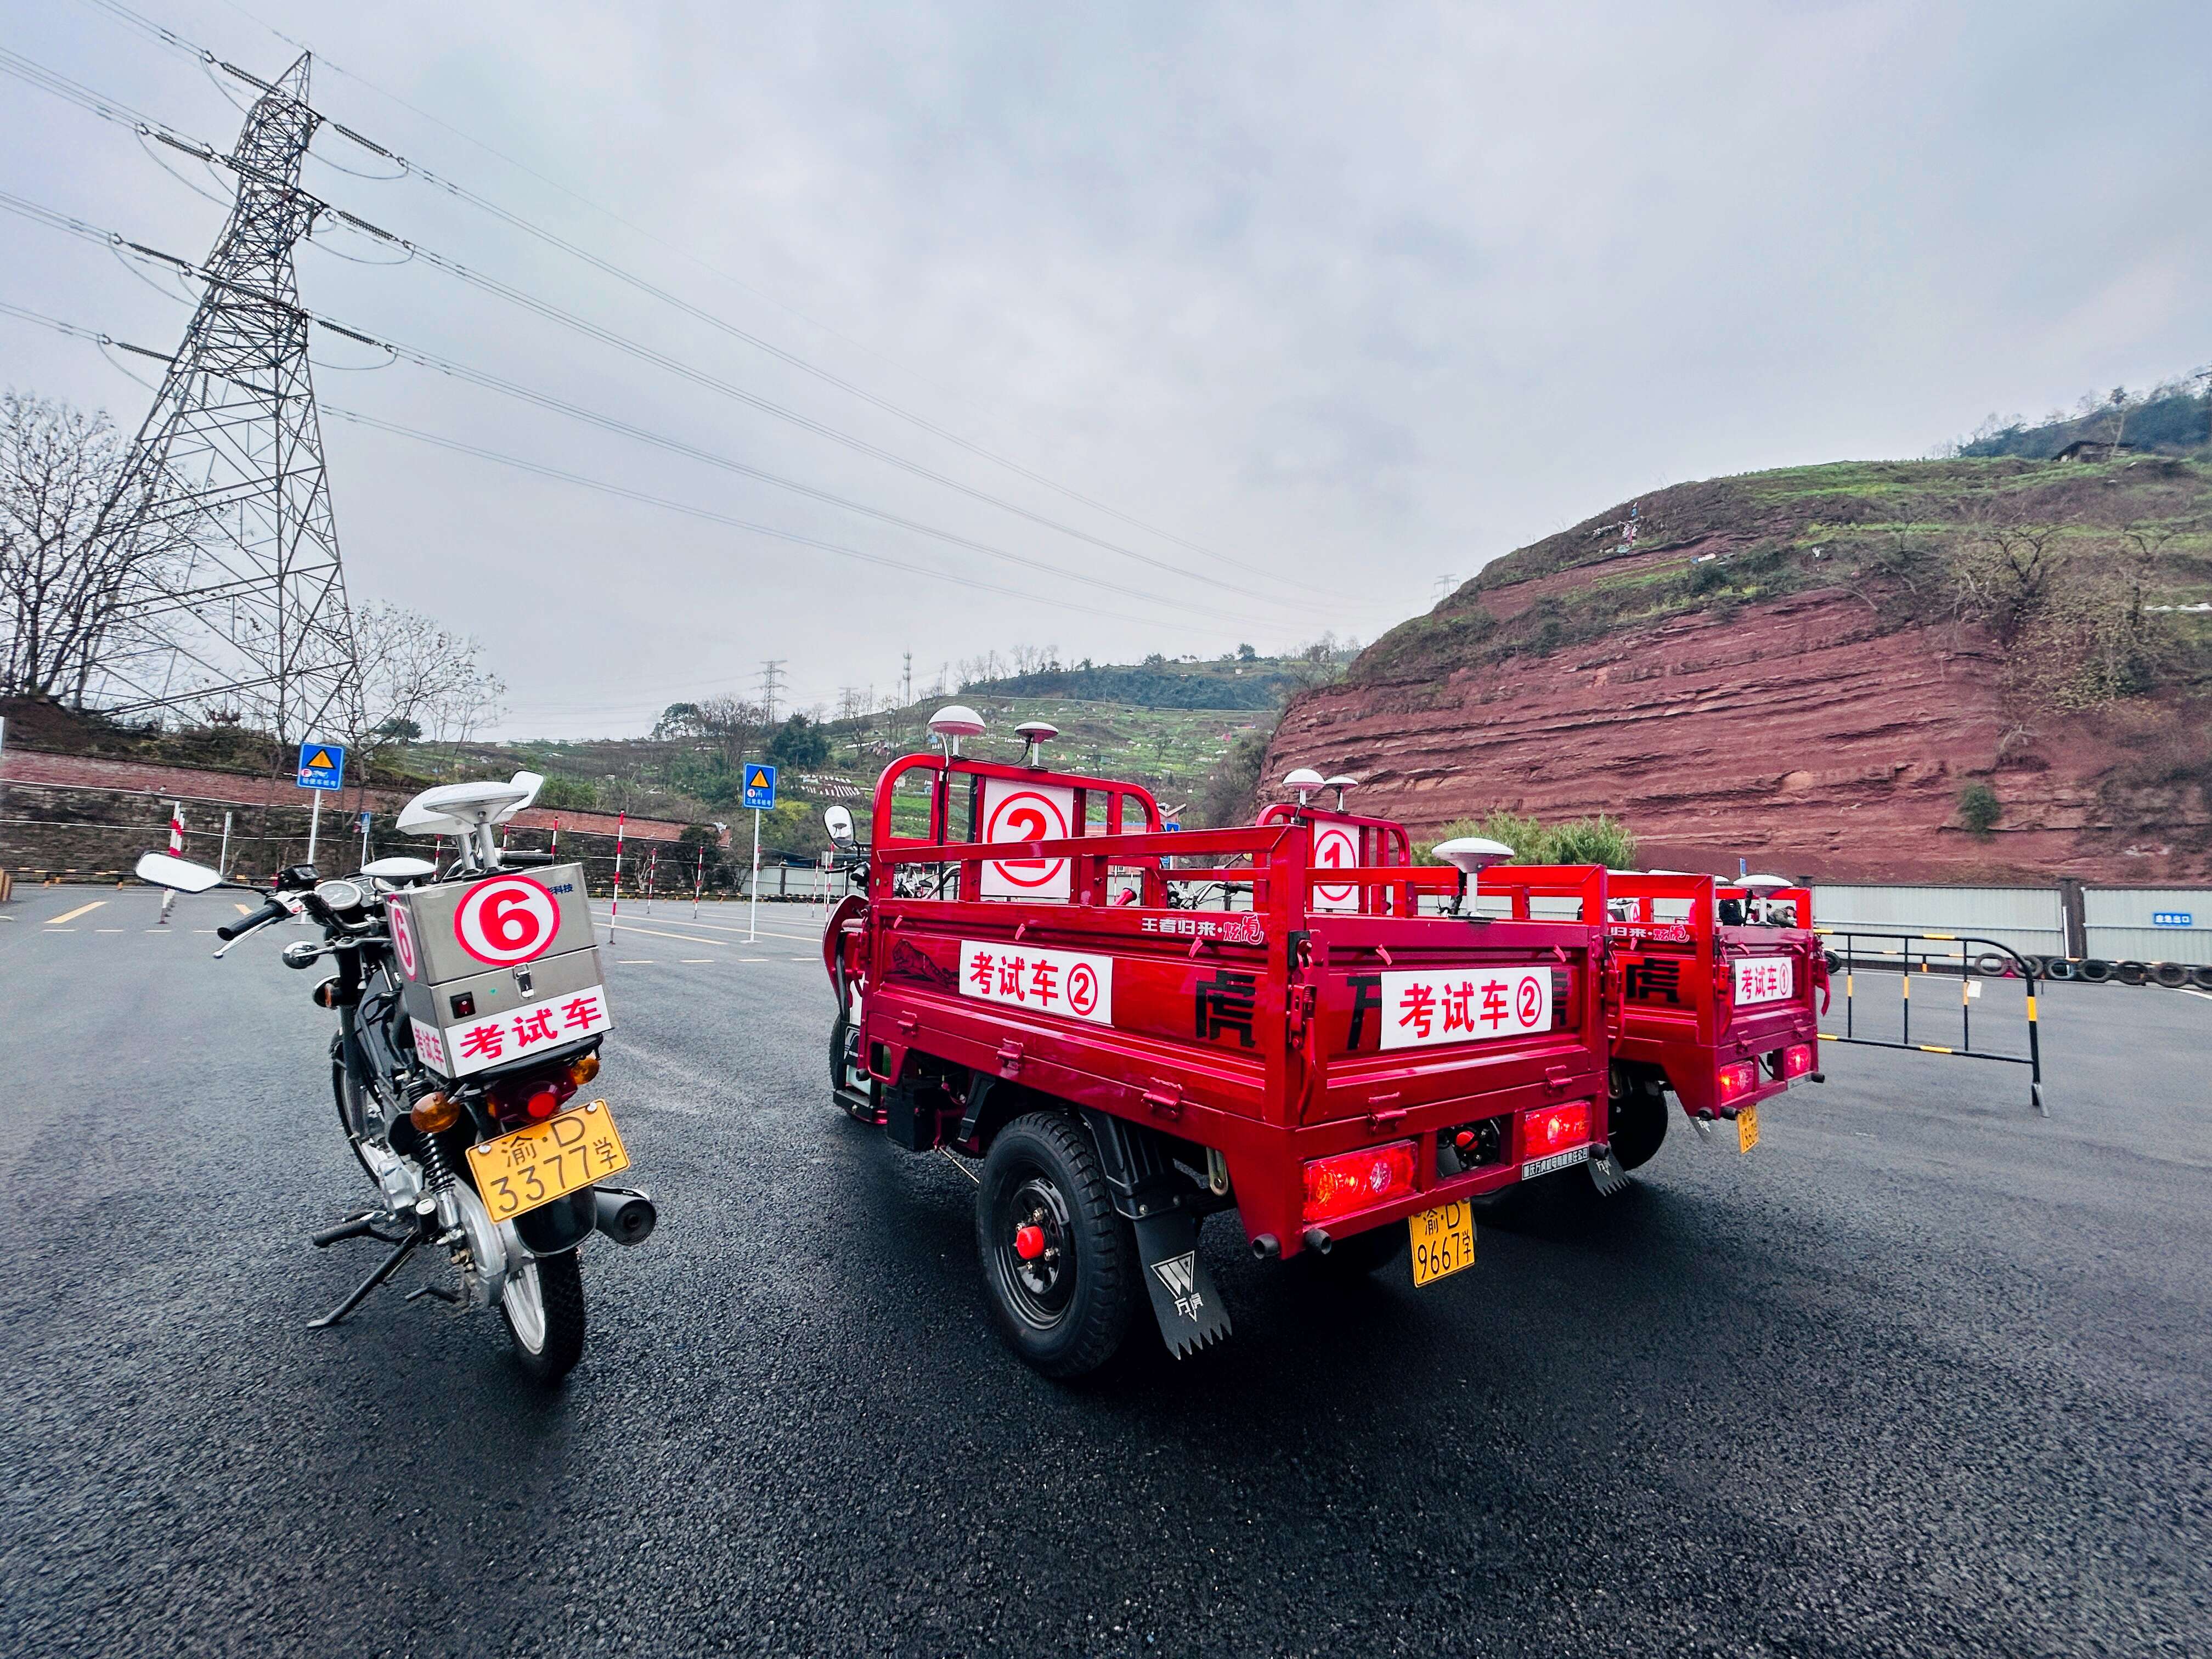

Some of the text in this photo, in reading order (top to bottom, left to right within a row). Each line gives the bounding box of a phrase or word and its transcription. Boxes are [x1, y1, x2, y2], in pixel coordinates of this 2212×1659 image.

[460, 997, 602, 1059] 考试车
[490, 1137, 617, 1212] 3377学
[1418, 1229, 1471, 1279] 9667学
